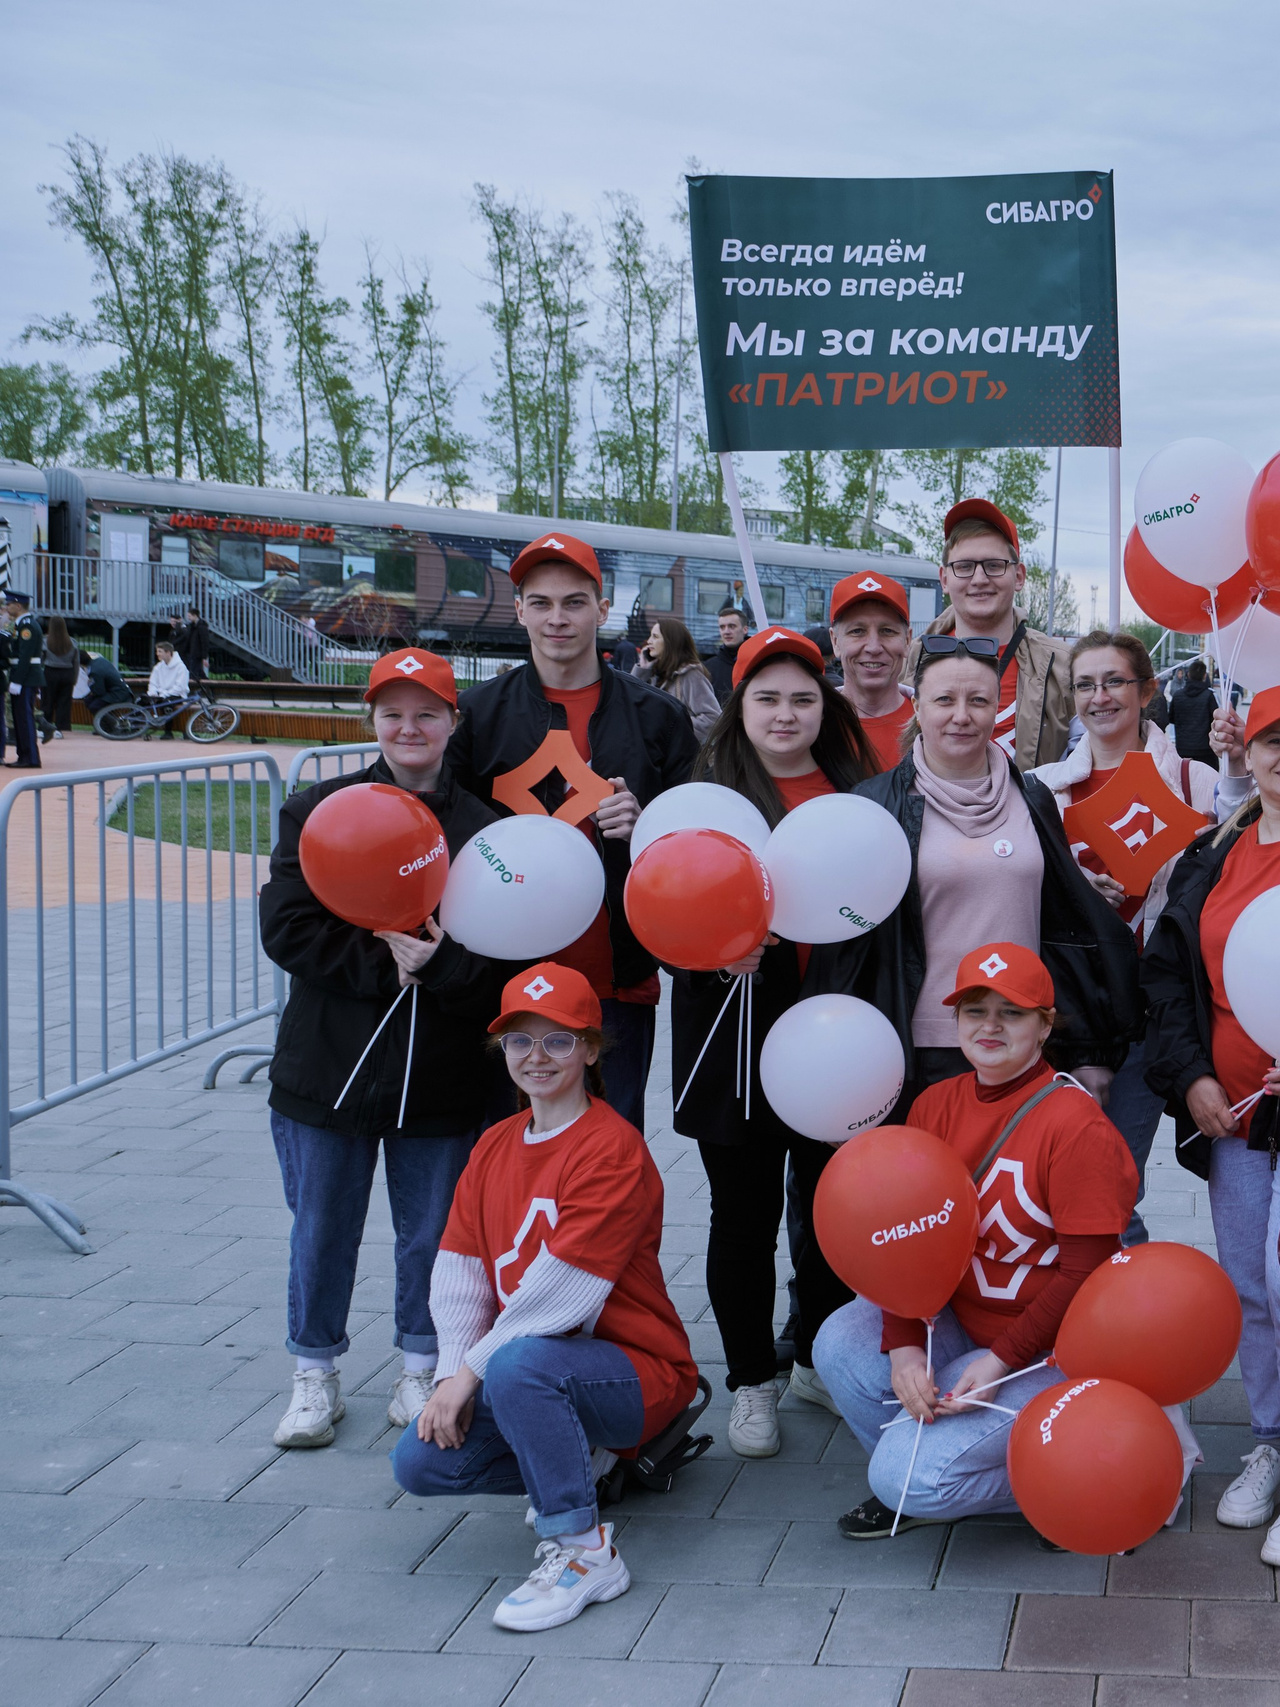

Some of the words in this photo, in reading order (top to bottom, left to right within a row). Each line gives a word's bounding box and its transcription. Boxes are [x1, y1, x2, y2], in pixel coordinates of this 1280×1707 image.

[985, 198, 1094, 224] СИБАГРО
[719, 238, 833, 267] Всегда
[843, 238, 927, 266] идём
[721, 276, 831, 297] только
[840, 271, 965, 302] вперёд!
[725, 321, 805, 357] Мы
[818, 327, 875, 356] за
[888, 323, 1094, 361] команду
[728, 369, 1008, 407] «ПАТРИОТ»
[169, 513, 221, 531] КАФЕ
[222, 518, 300, 538] СТАНЦИЯ
[1143, 502, 1195, 526] СИБАГРО
[398, 843, 445, 877] СИБАГРО
[474, 836, 513, 883] СИБАГРО
[847, 1087, 901, 1132] СИБАГРО
[871, 1209, 950, 1246] СИБАГРО
[1039, 1379, 1100, 1433] СИБАГРО
